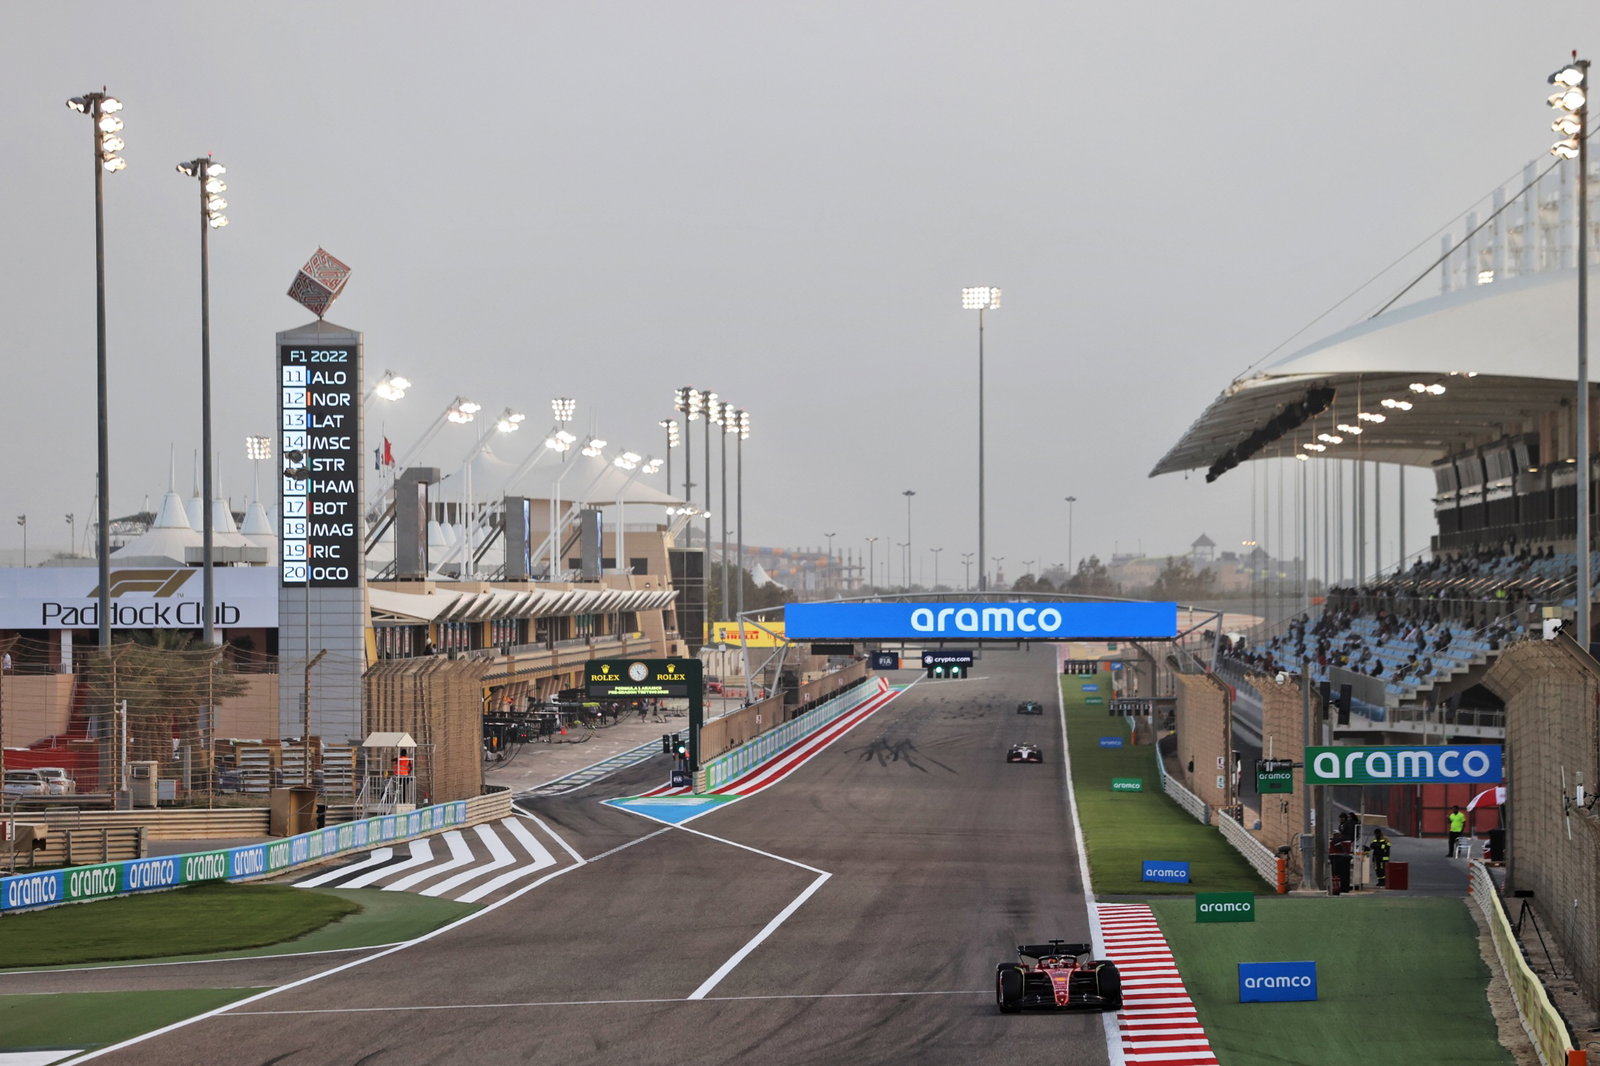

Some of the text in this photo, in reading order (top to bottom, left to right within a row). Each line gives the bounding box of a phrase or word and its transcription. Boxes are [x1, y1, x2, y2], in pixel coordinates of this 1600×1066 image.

[290, 351, 348, 362] F1 2022
[286, 370, 346, 384] 11 ALO
[286, 392, 350, 406] 12 NOR
[286, 414, 344, 428] 13 LAT
[285, 436, 350, 450] 14 MSC
[313, 458, 345, 471] STR
[286, 479, 354, 493] 16 HAM
[286, 501, 347, 515] 17 BOT
[286, 523, 354, 536] 18 MAG
[286, 545, 340, 558] 19 RIC
[285, 567, 348, 580] 20 OCO
[910, 608, 1062, 632] aramco
[1313, 750, 1490, 778] aramco
[186, 854, 225, 881] aramco
[234, 848, 263, 875] aramco
[130, 859, 174, 888] aramco
[1145, 868, 1186, 878] aramco
[70, 867, 117, 897] aramco
[9, 875, 57, 907] aramco
[1200, 902, 1250, 912] aramco
[1245, 976, 1311, 988] aramco
